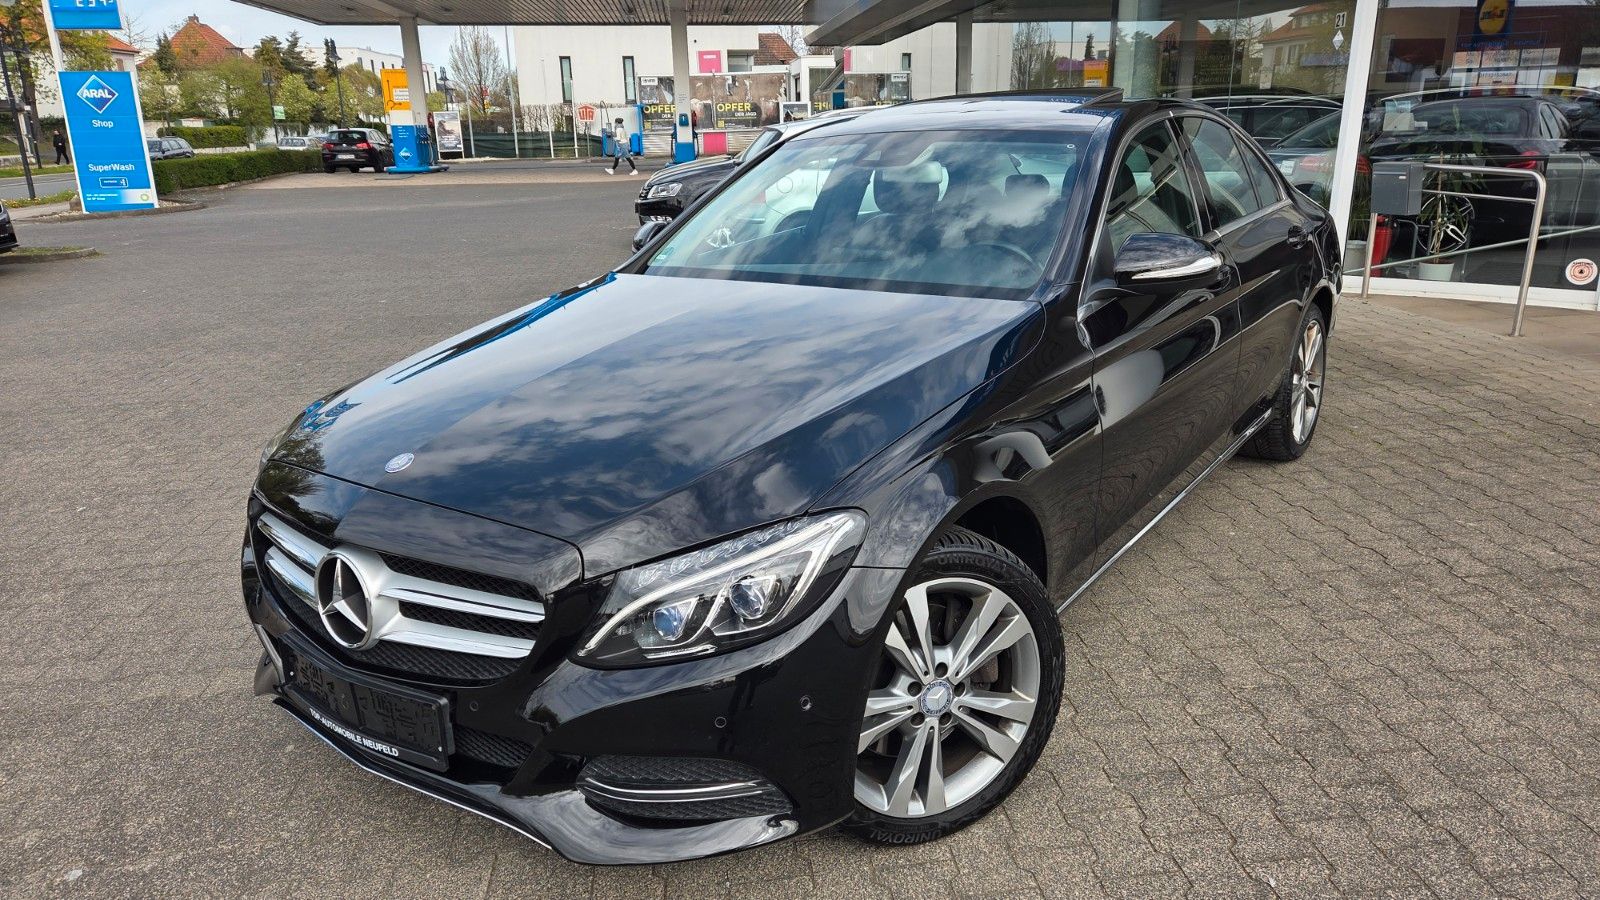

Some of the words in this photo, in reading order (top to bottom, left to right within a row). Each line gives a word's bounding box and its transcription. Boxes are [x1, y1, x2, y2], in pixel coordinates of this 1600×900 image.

[1336, 14, 1345, 27] 21
[83, 89, 113, 98] ARAL
[716, 103, 751, 111] OPFER
[92, 120, 113, 128] Shop
[88, 163, 135, 172] SuperWash
[309, 707, 362, 744] TOP-AUTOMOBILE
[363, 738, 399, 757] NEUFELD
[870, 829, 940, 843] UNIROYAL
